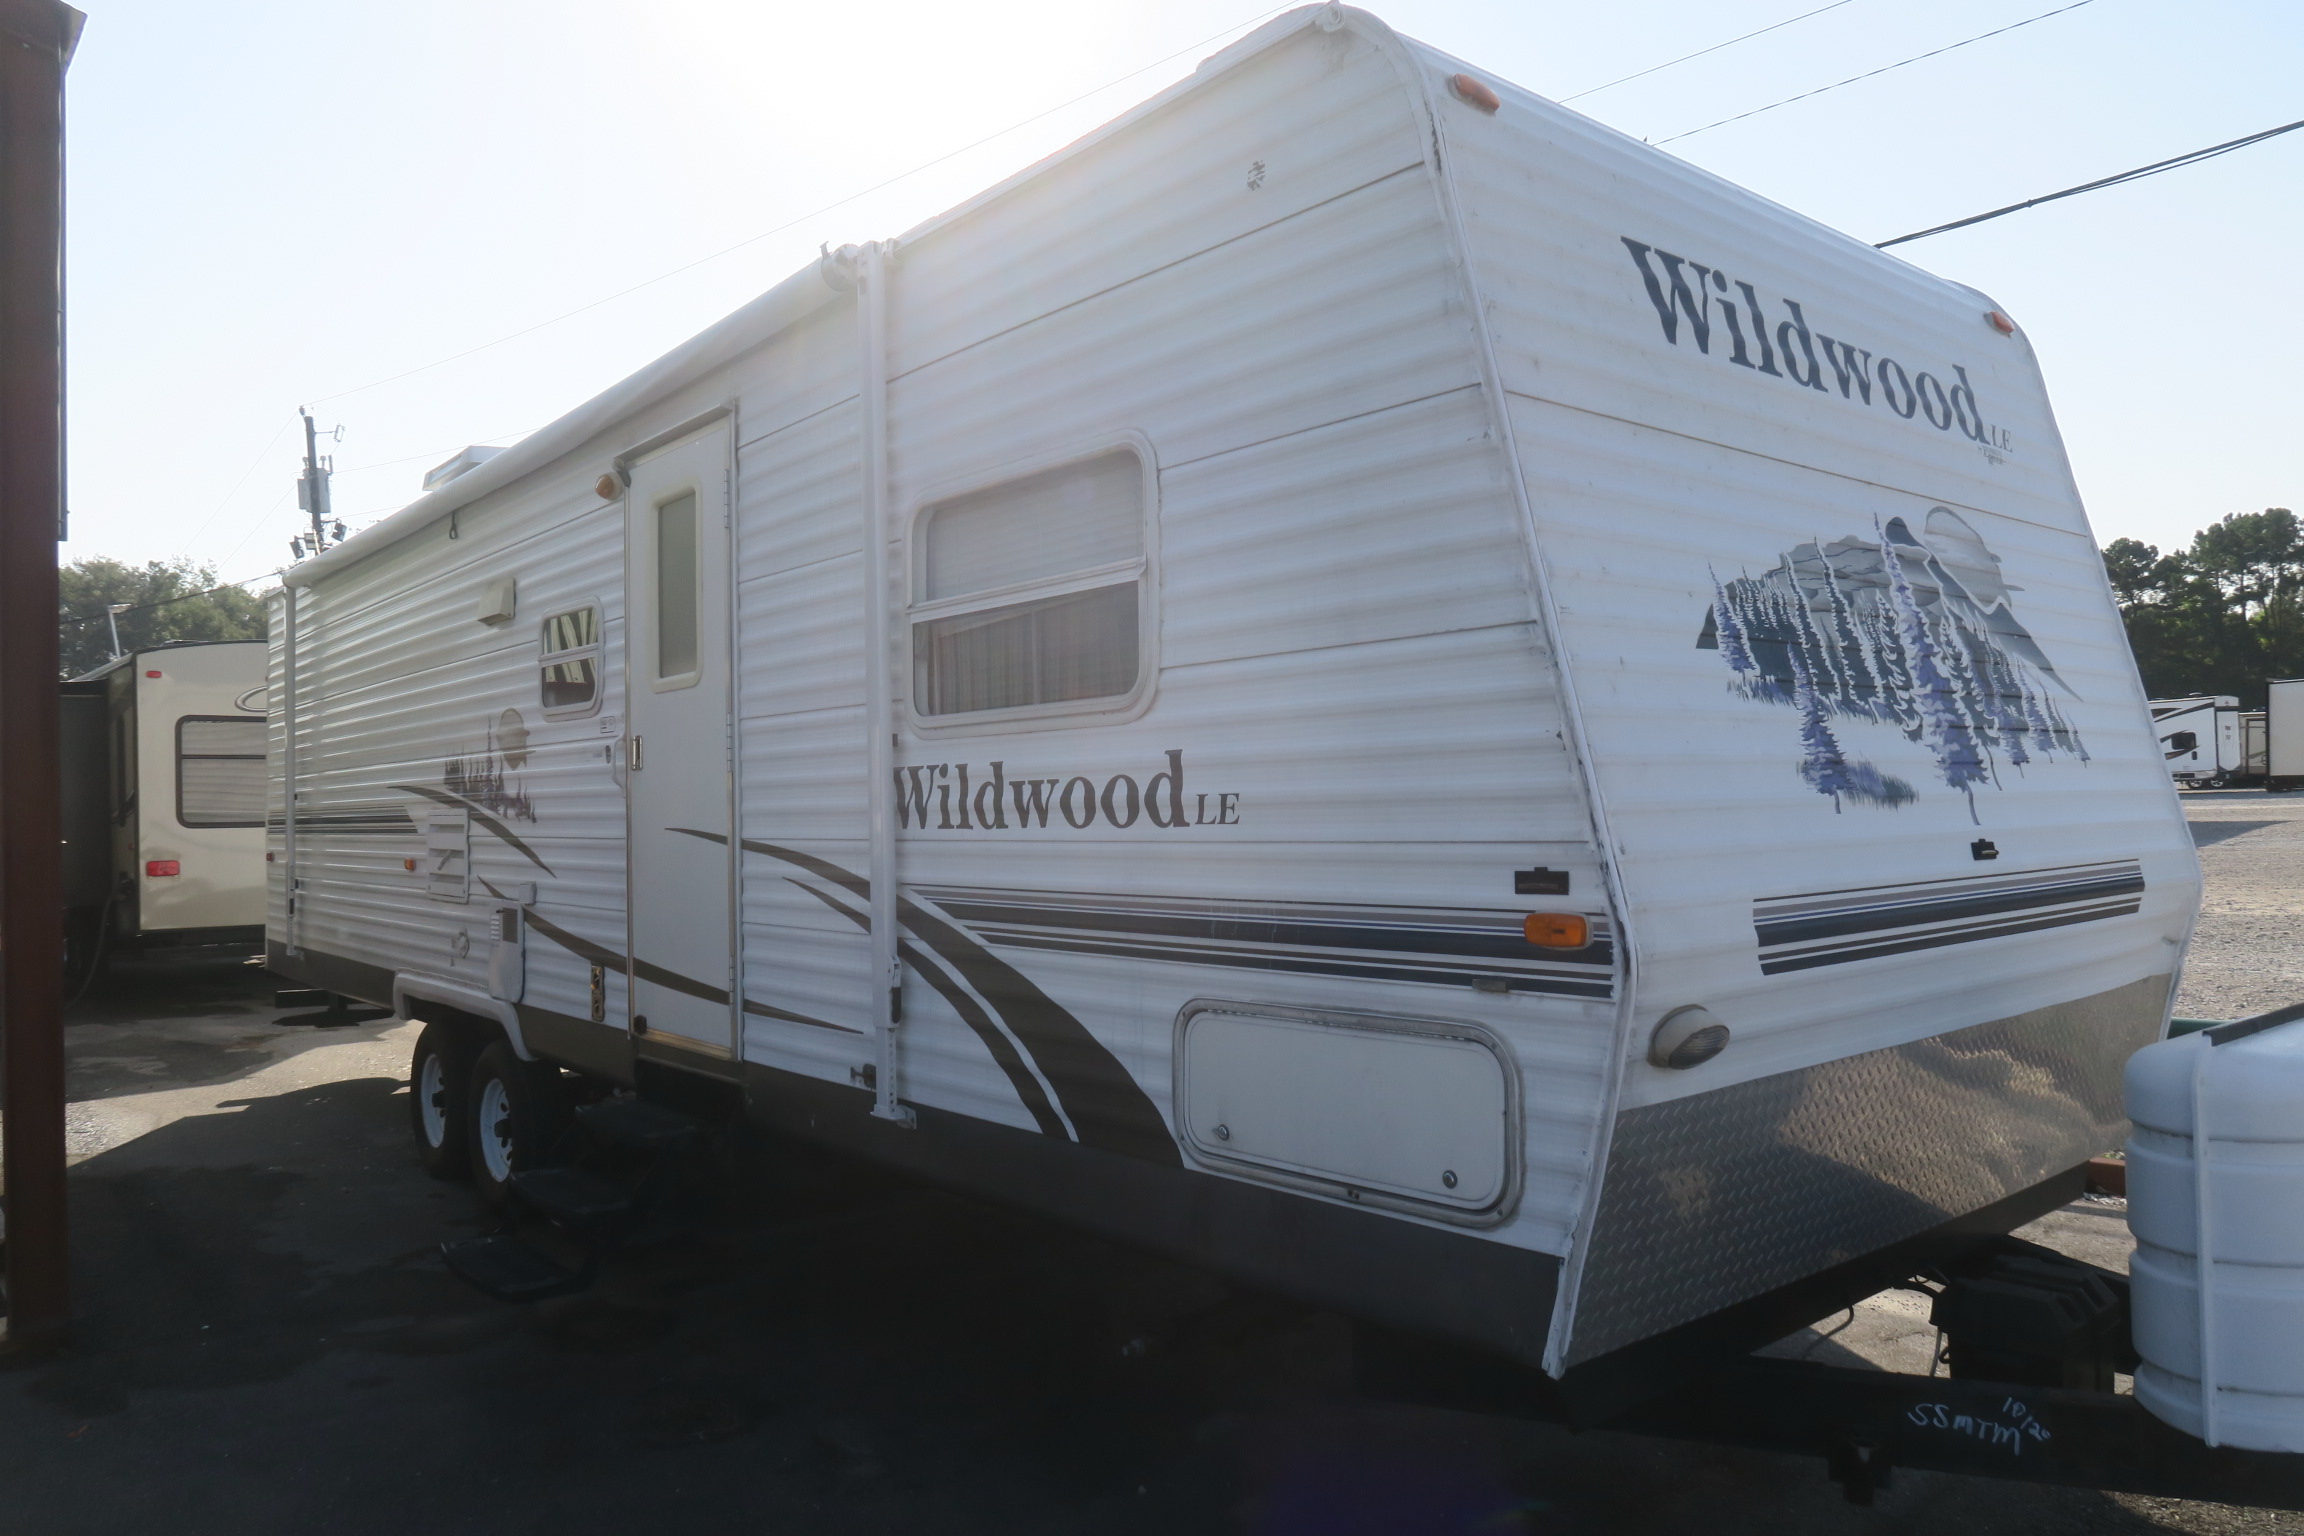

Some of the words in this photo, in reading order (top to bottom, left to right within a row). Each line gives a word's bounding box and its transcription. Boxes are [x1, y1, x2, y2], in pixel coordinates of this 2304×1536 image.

[1620, 235, 1988, 445] Wildwood
[1990, 424, 2013, 453] LE
[893, 749, 1190, 830] Wildwood
[1195, 793, 1240, 825] LE
